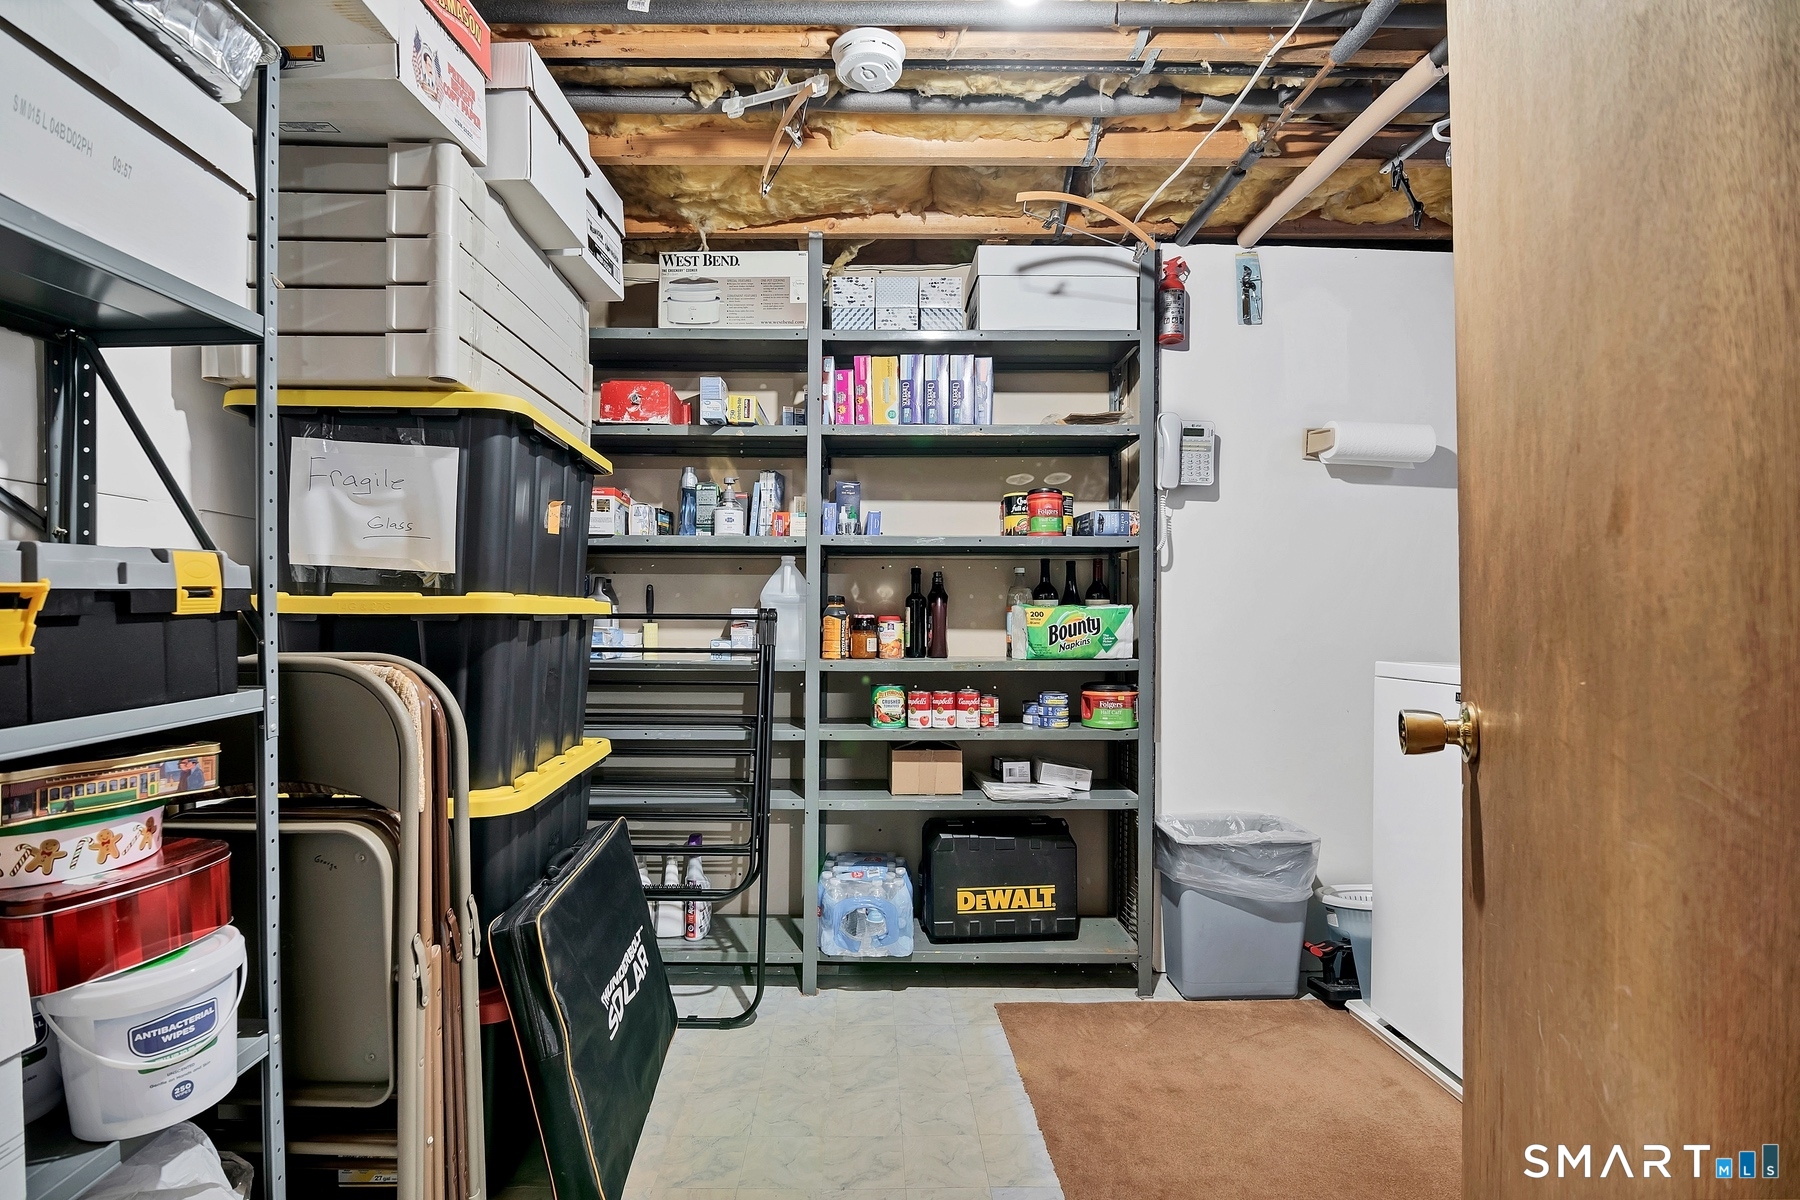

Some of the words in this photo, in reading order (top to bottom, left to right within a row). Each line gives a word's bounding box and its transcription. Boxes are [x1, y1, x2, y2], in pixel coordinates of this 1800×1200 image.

[112, 155, 133, 180] 09:57
[661, 253, 700, 267] WEST
[308, 456, 405, 495] Fragile
[1037, 508, 1058, 516] Folgers
[366, 516, 414, 532] Glass
[1048, 616, 1101, 646] Bounty
[1059, 638, 1091, 653] Napkins
[1099, 700, 1123, 709] Folgers
[601, 925, 643, 1010] THUNDERBOLT
[608, 944, 649, 1041] SOLAR
[134, 1007, 215, 1042] ANTIBACTERIAL
[161, 1024, 196, 1043] WIPES
[174, 1082, 192, 1094] 250
